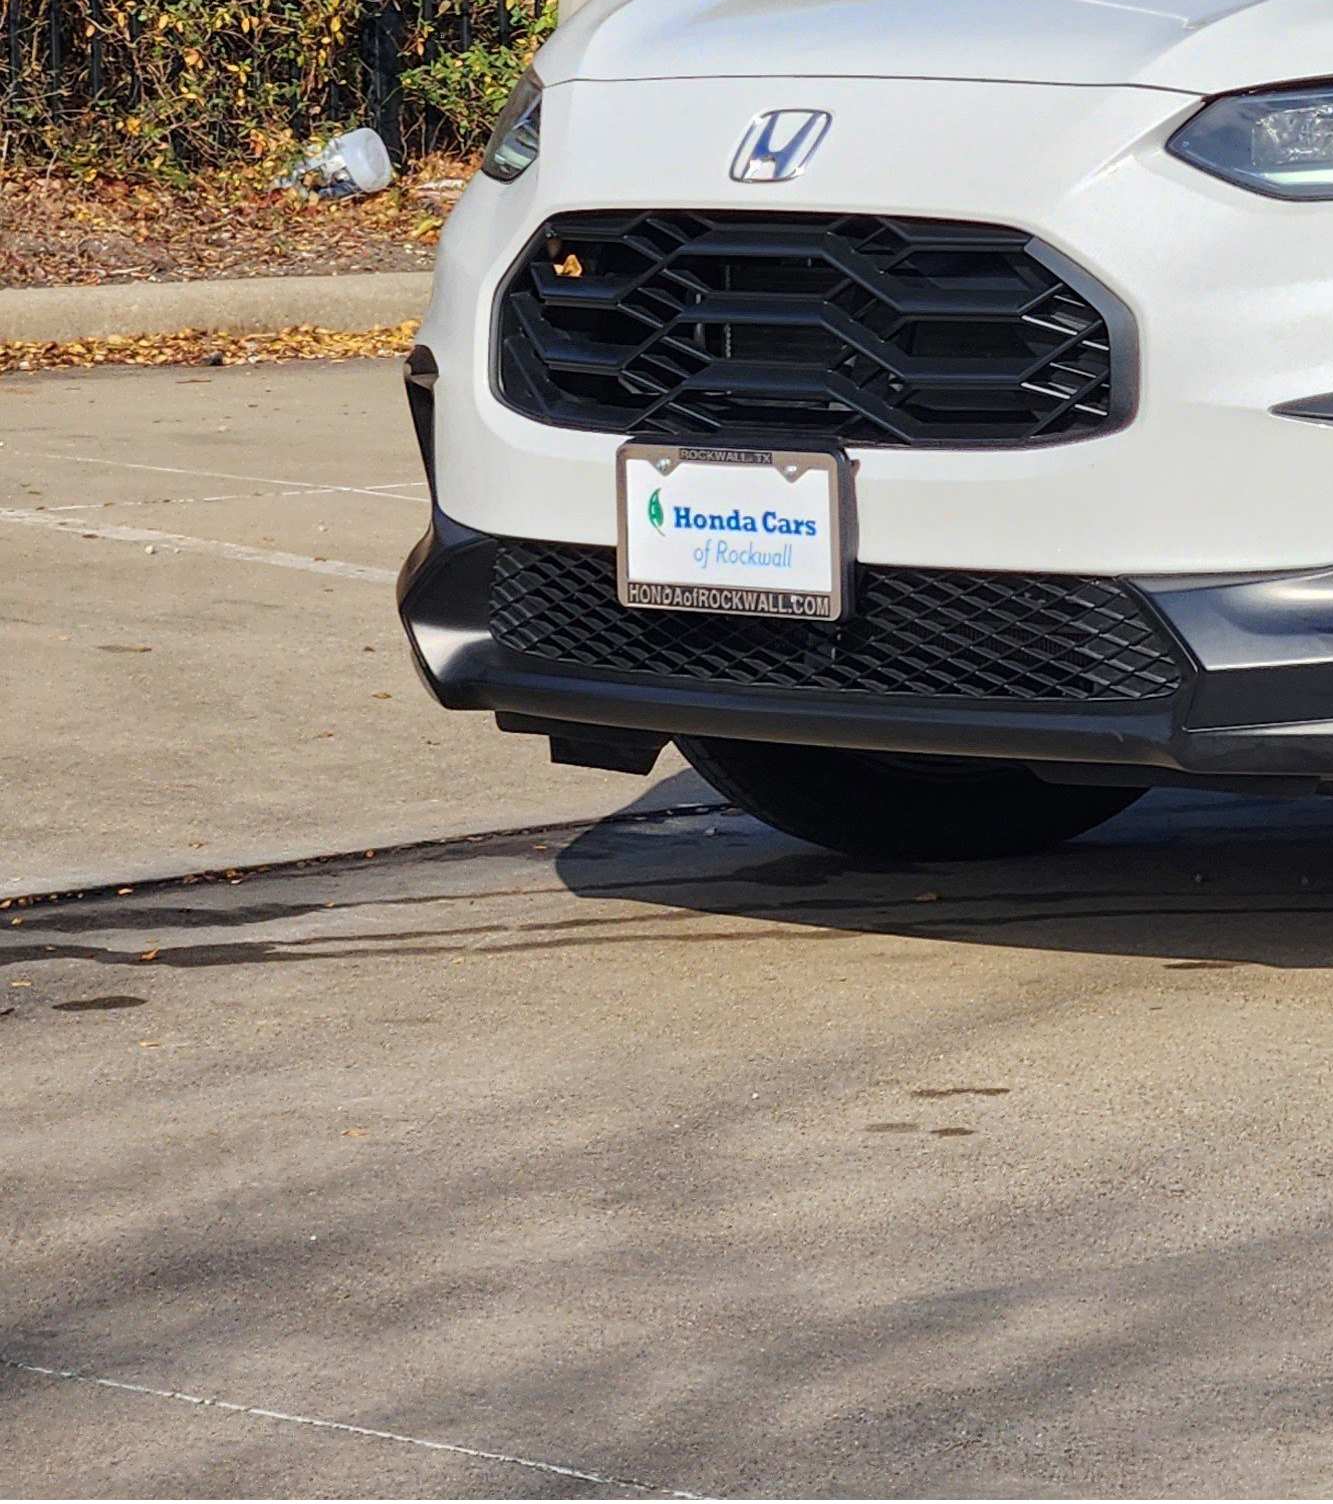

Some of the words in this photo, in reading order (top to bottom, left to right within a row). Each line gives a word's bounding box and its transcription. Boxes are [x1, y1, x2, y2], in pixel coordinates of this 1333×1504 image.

[755, 453, 772, 464] TX
[673, 506, 757, 532] Honda
[762, 511, 817, 536] Cars
[694, 538, 712, 568] of
[716, 540, 793, 567] Rockwall
